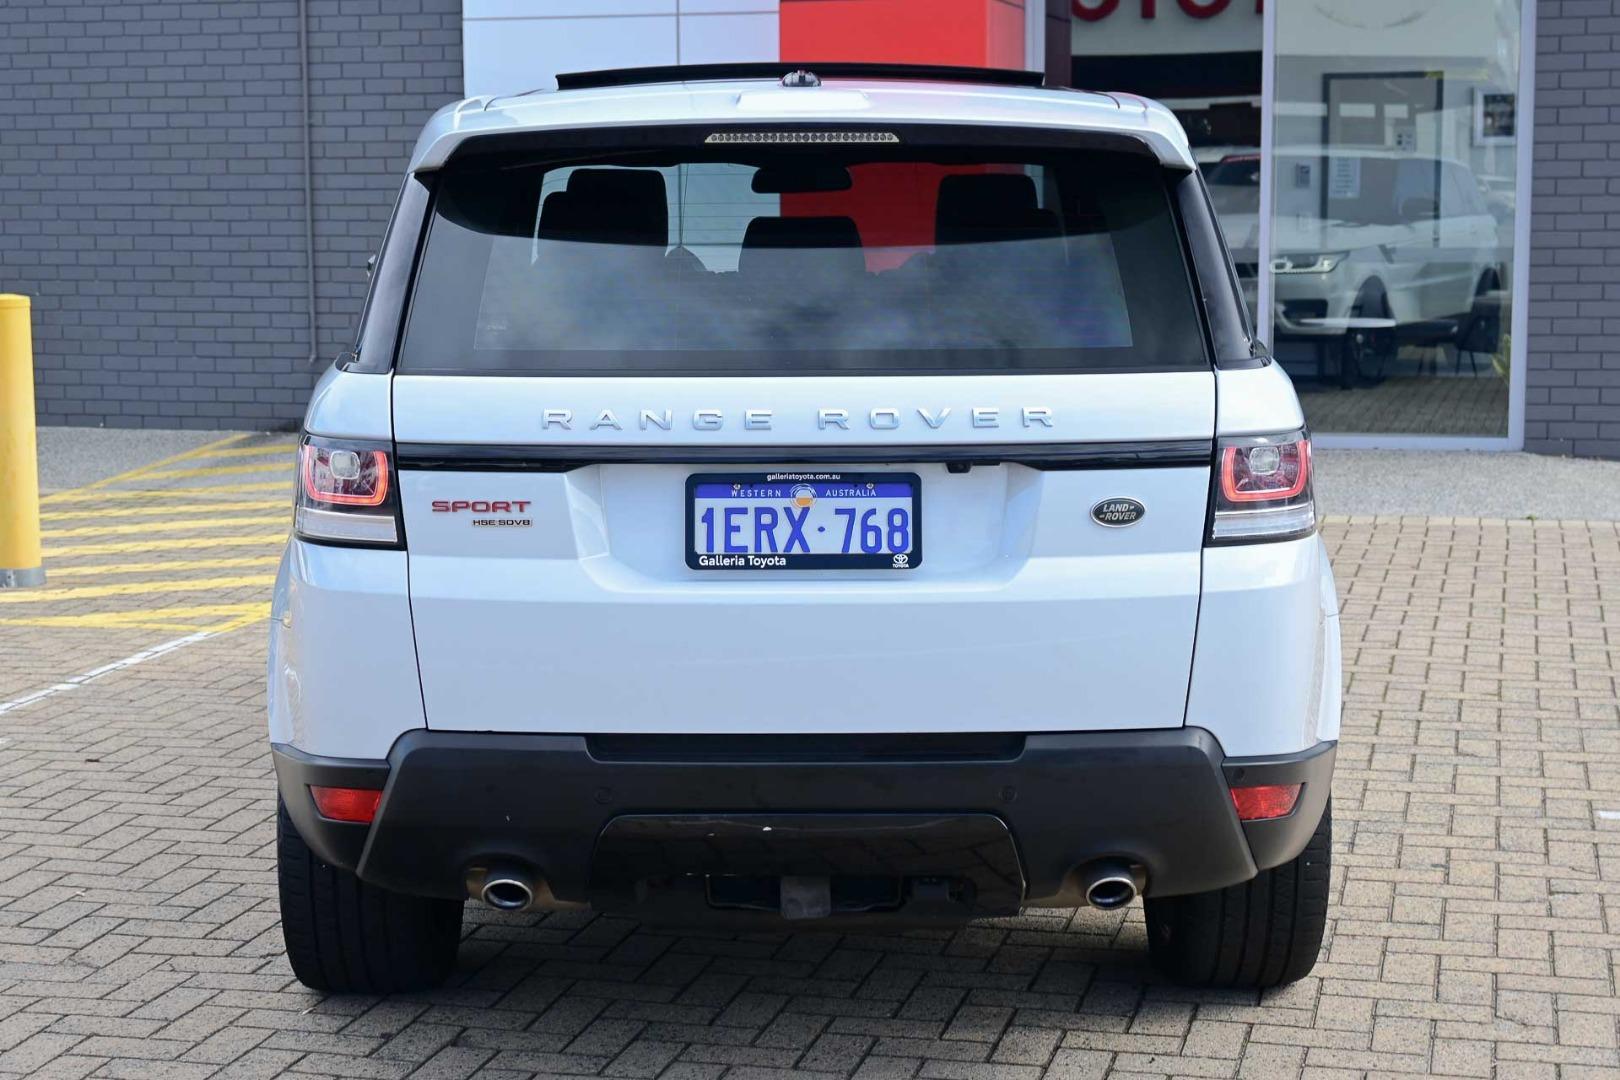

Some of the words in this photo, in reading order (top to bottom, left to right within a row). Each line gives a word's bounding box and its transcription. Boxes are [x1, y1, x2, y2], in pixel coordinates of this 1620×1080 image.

[541, 408, 773, 431] RANGE
[817, 407, 1055, 429] ROVER
[766, 472, 841, 482] galleriatoyota.com.au
[731, 489, 782, 498] WESTERN
[825, 488, 877, 497] AUSTRALIA
[431, 500, 532, 513] SPORT
[698, 555, 745, 567] Galleria
[748, 555, 787, 569] Toyota
